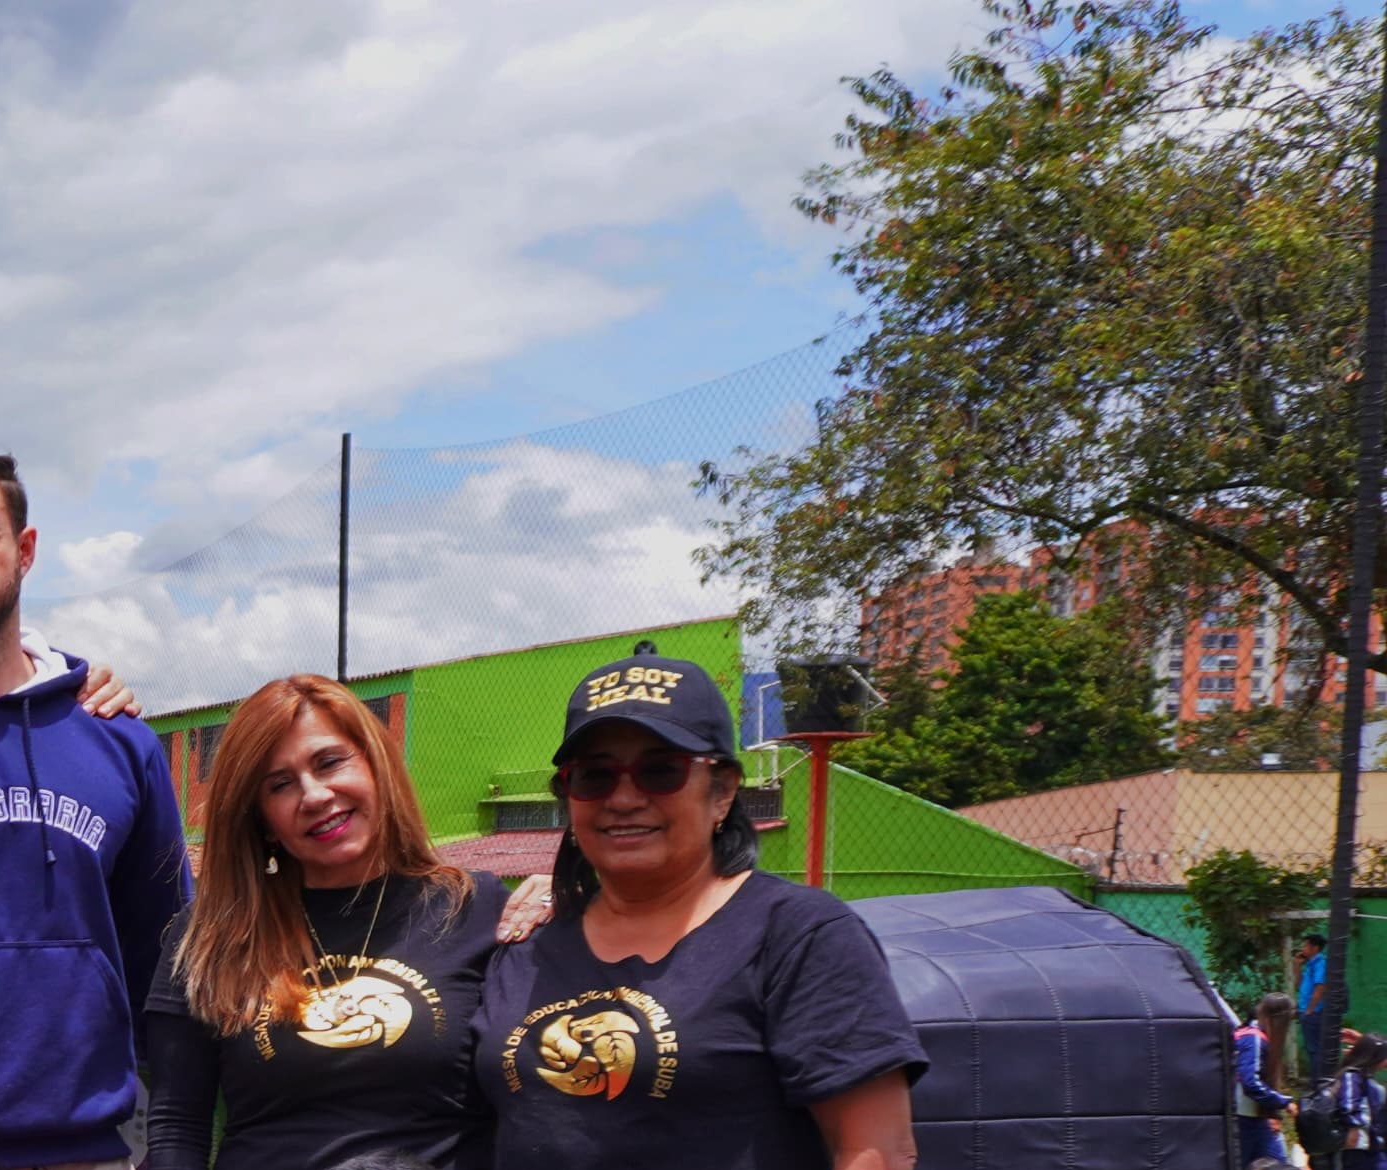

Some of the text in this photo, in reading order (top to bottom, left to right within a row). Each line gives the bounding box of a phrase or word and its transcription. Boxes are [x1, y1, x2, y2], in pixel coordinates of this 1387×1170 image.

[587, 666, 683, 695] YO SOY
[586, 684, 671, 712] MEAL
[506, 1025, 528, 1047] DE
[655, 1030, 678, 1054] DE
[502, 1047, 523, 1093] MESA
[648, 1057, 678, 1099] SUBA
